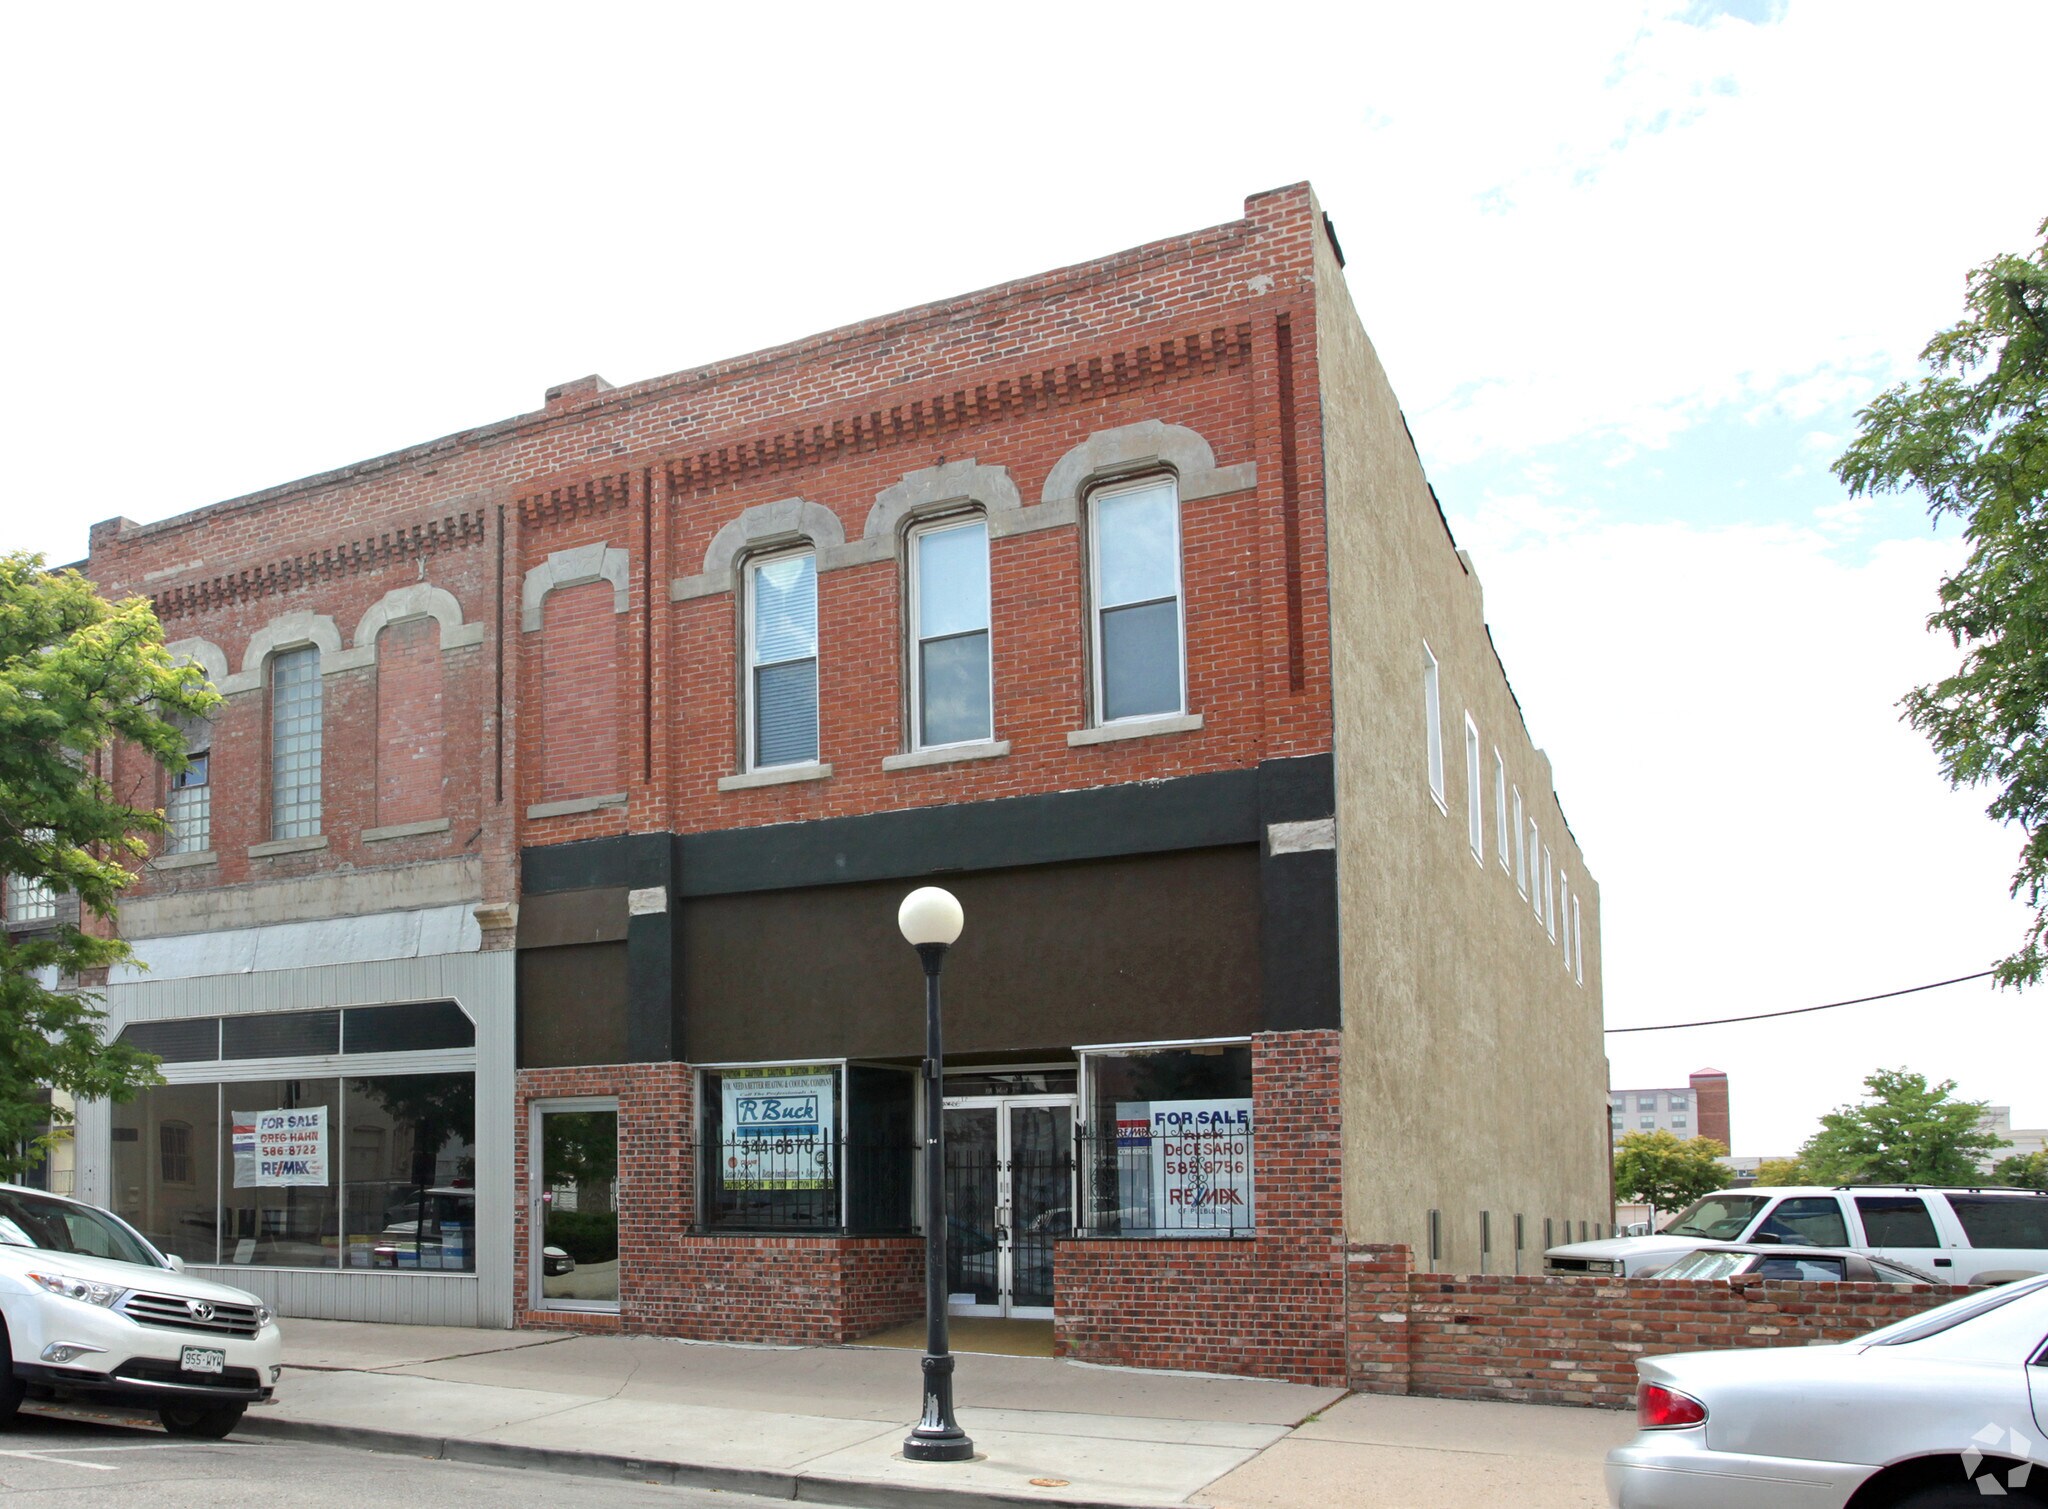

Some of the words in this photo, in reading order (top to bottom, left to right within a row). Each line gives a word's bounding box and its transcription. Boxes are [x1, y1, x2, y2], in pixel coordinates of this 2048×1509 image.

[739, 1100, 758, 1122] R
[761, 1098, 814, 1121] Buck
[1155, 1112, 1193, 1126] FOR
[1197, 1110, 1249, 1125] SALE
[261, 1117, 284, 1129] FOR
[288, 1114, 319, 1128] SALE
[260, 1133, 287, 1144] GREG
[290, 1131, 319, 1142] HAHN
[1165, 1142, 1244, 1156] DeCESARO
[261, 1160, 311, 1177] RE/MAX
[1170, 1187, 1244, 1207] RE/MAX
